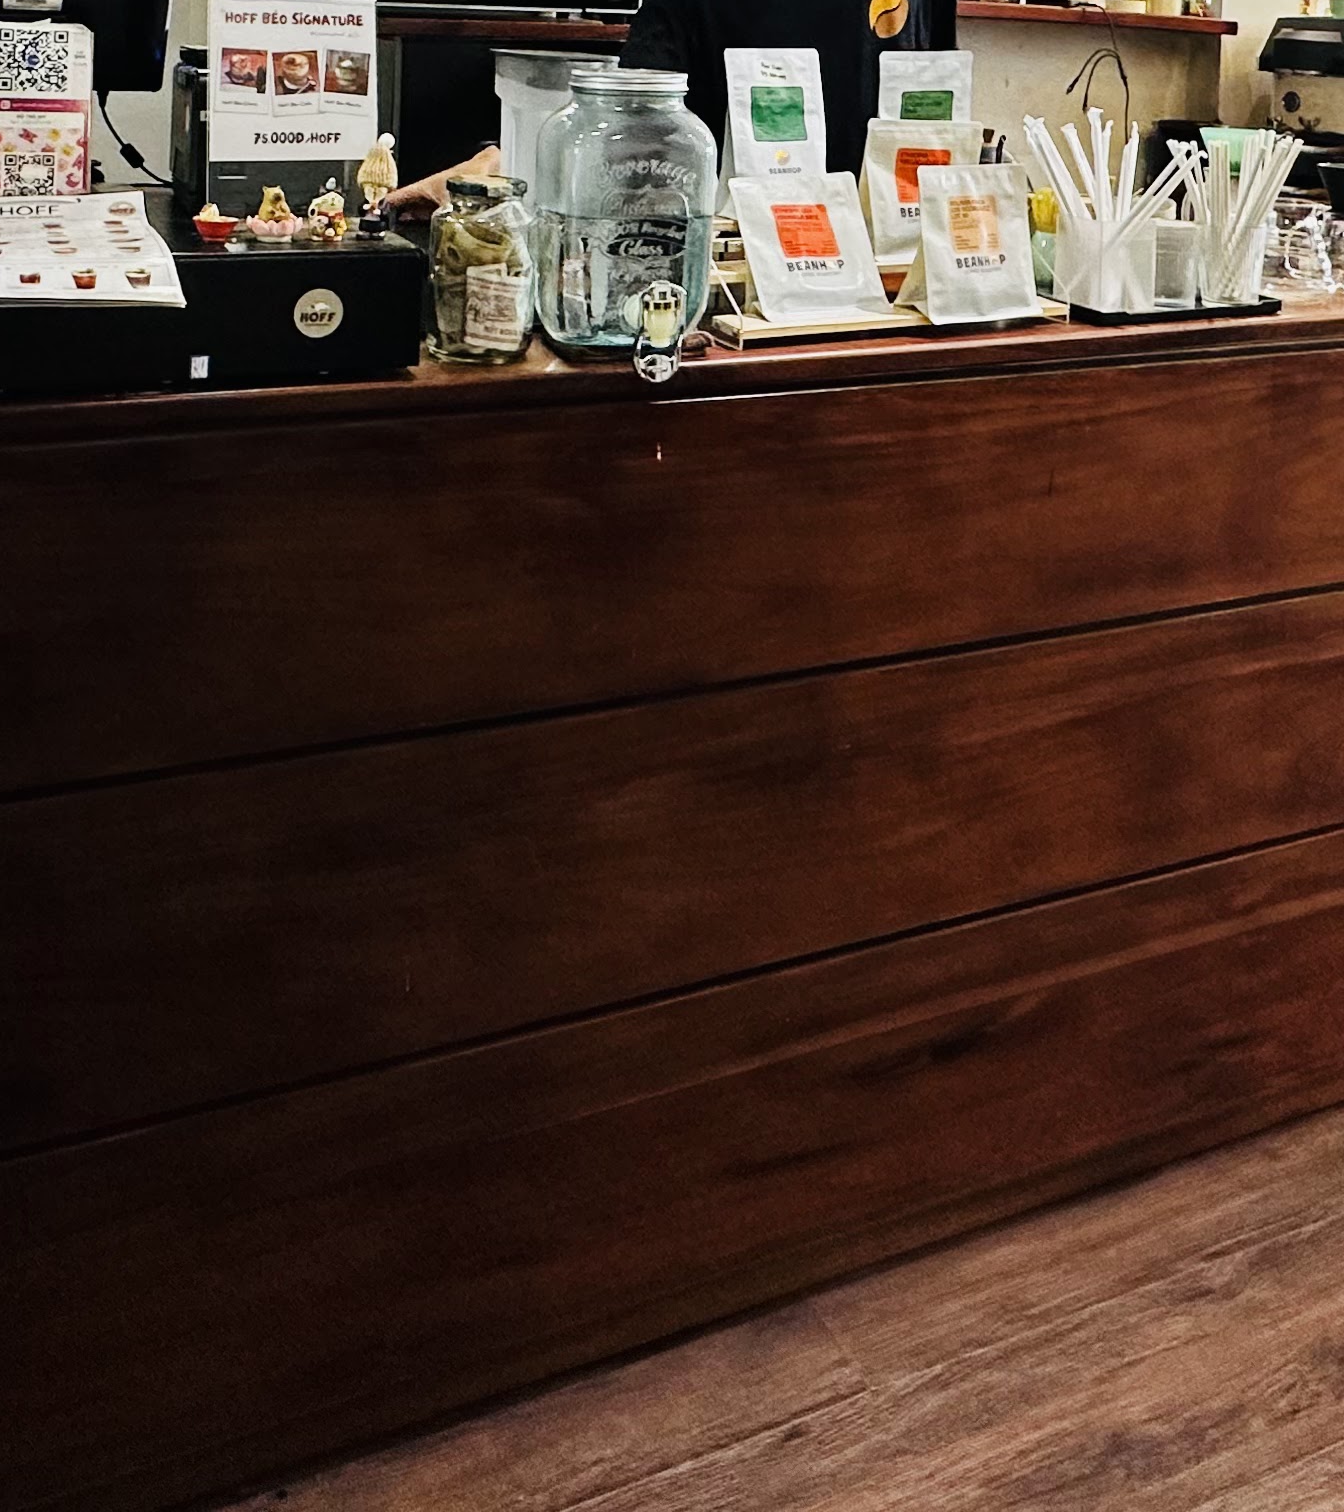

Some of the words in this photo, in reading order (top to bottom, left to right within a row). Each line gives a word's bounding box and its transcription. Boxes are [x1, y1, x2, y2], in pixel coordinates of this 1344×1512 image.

[224, 11, 258, 25] HOFF
[785, 258, 845, 273] BEANHP
[299, 312, 337, 323] HOFF
